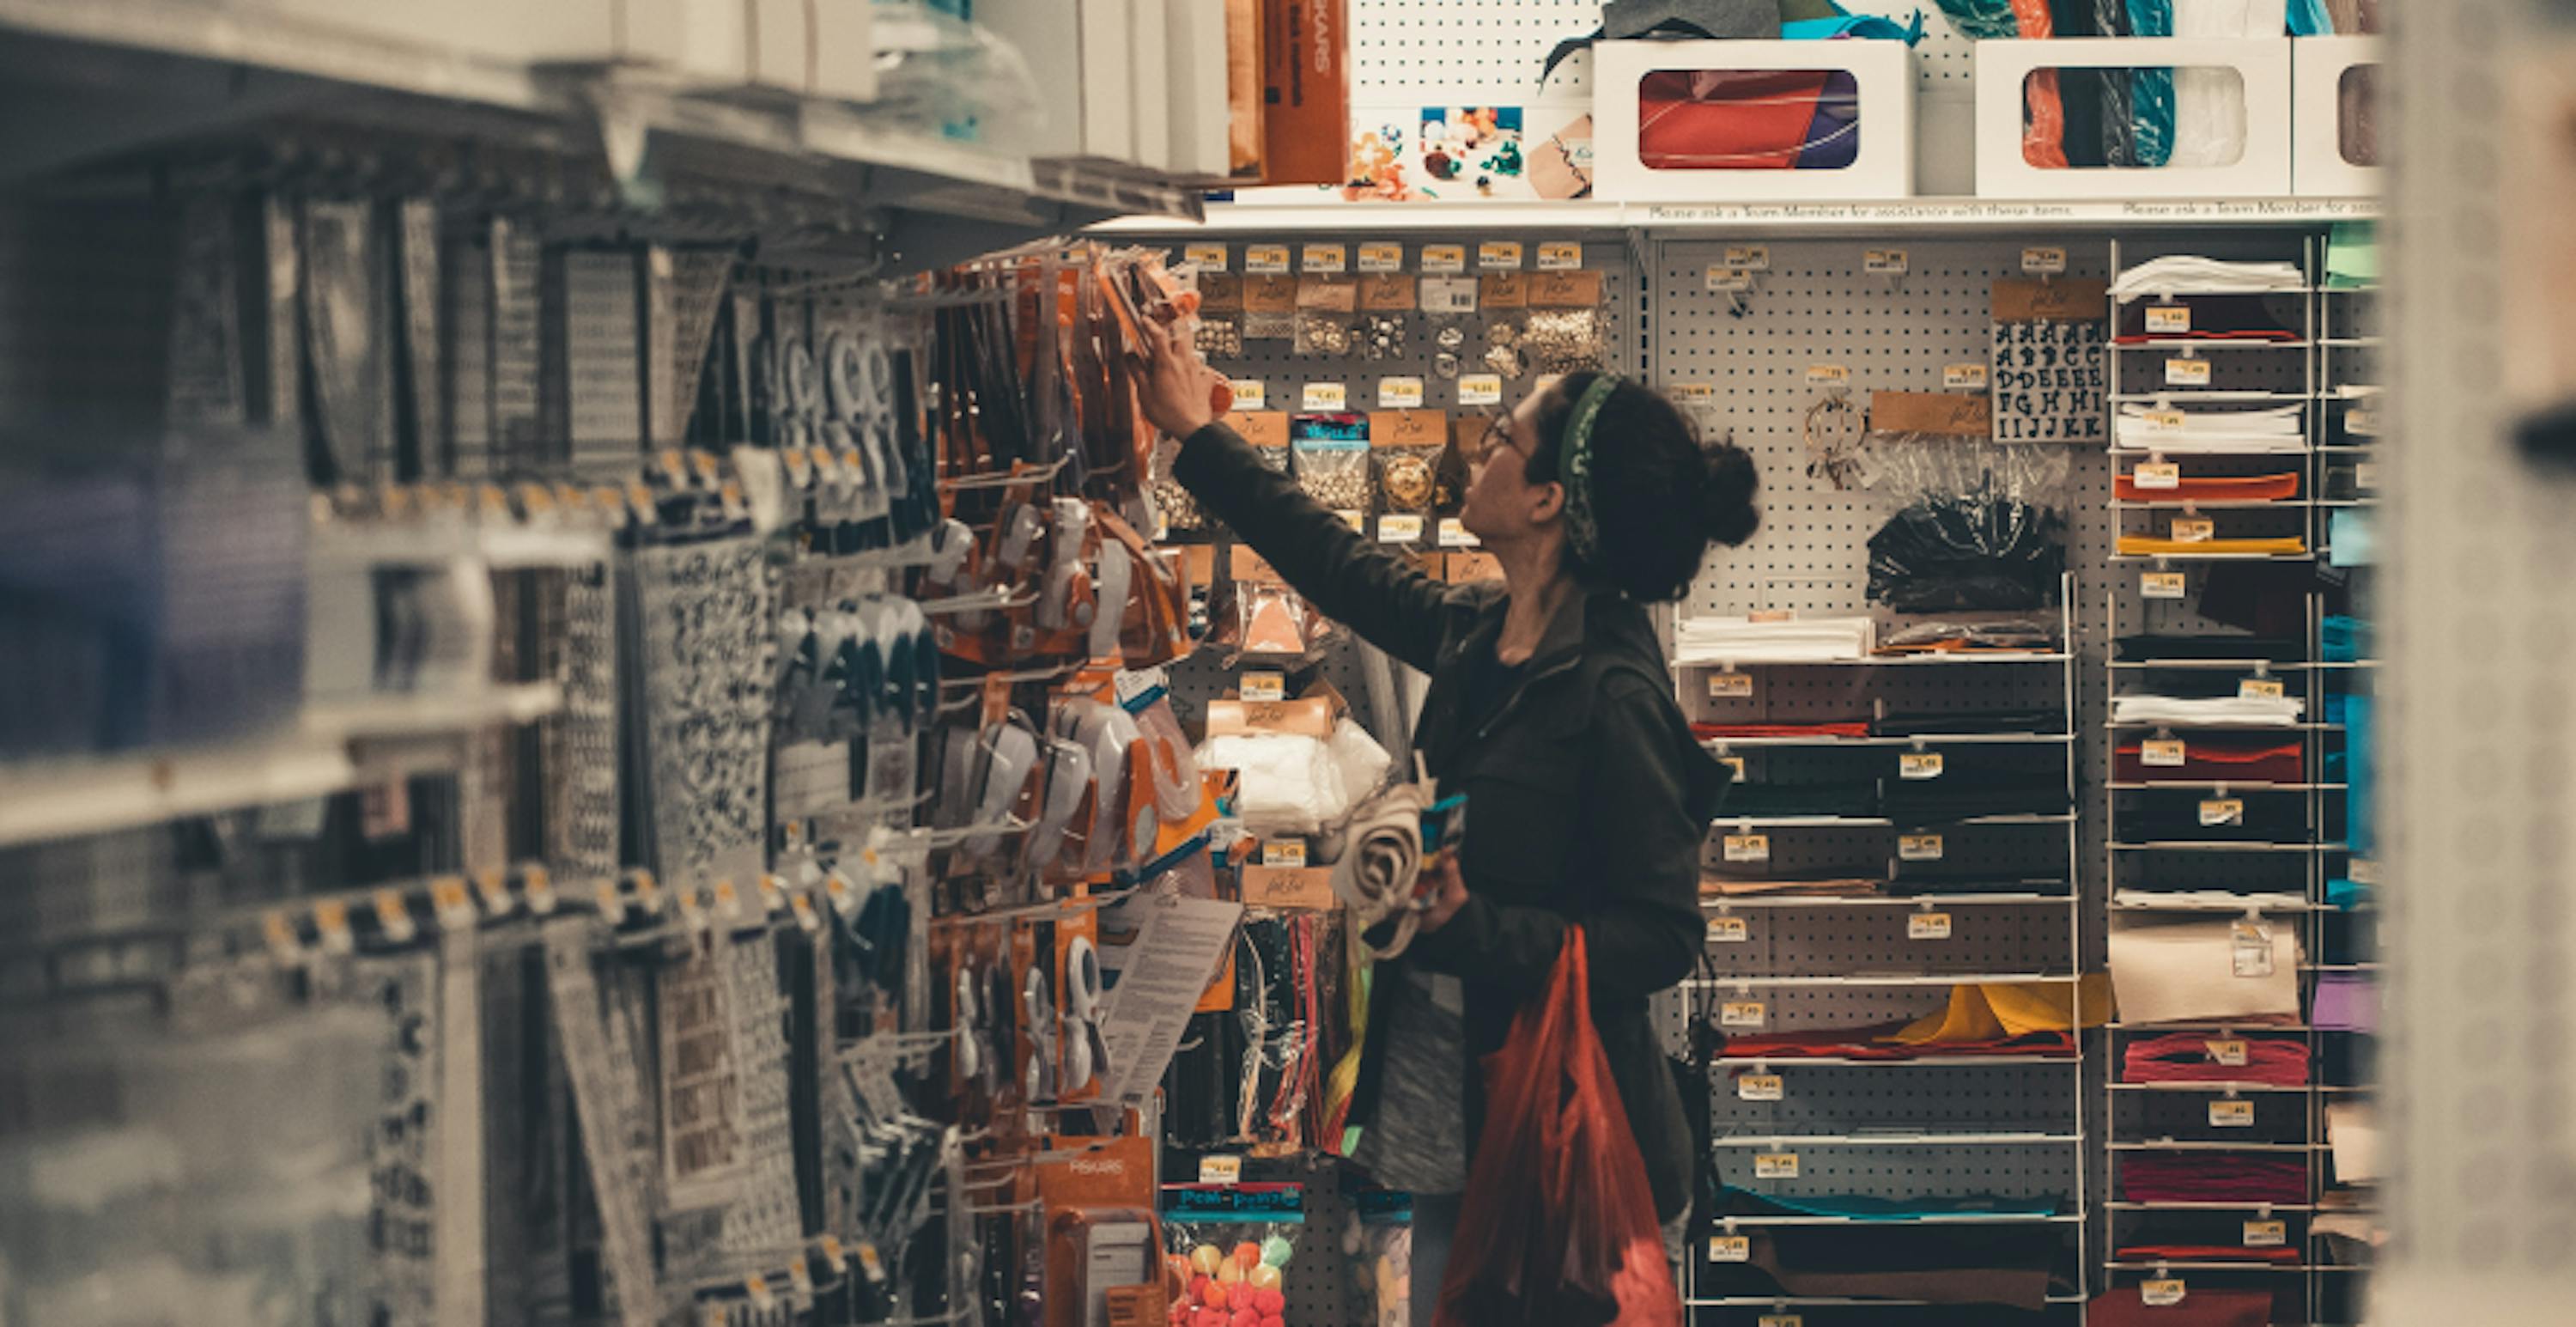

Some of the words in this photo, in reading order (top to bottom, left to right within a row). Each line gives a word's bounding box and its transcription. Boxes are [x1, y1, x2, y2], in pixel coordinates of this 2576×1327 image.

[1649, 204, 1696, 218] Please
[2123, 201, 2170, 215] Please
[2175, 202, 2195, 214] ask
[2215, 201, 2251, 214] Team
[2257, 201, 2319, 214] Member
